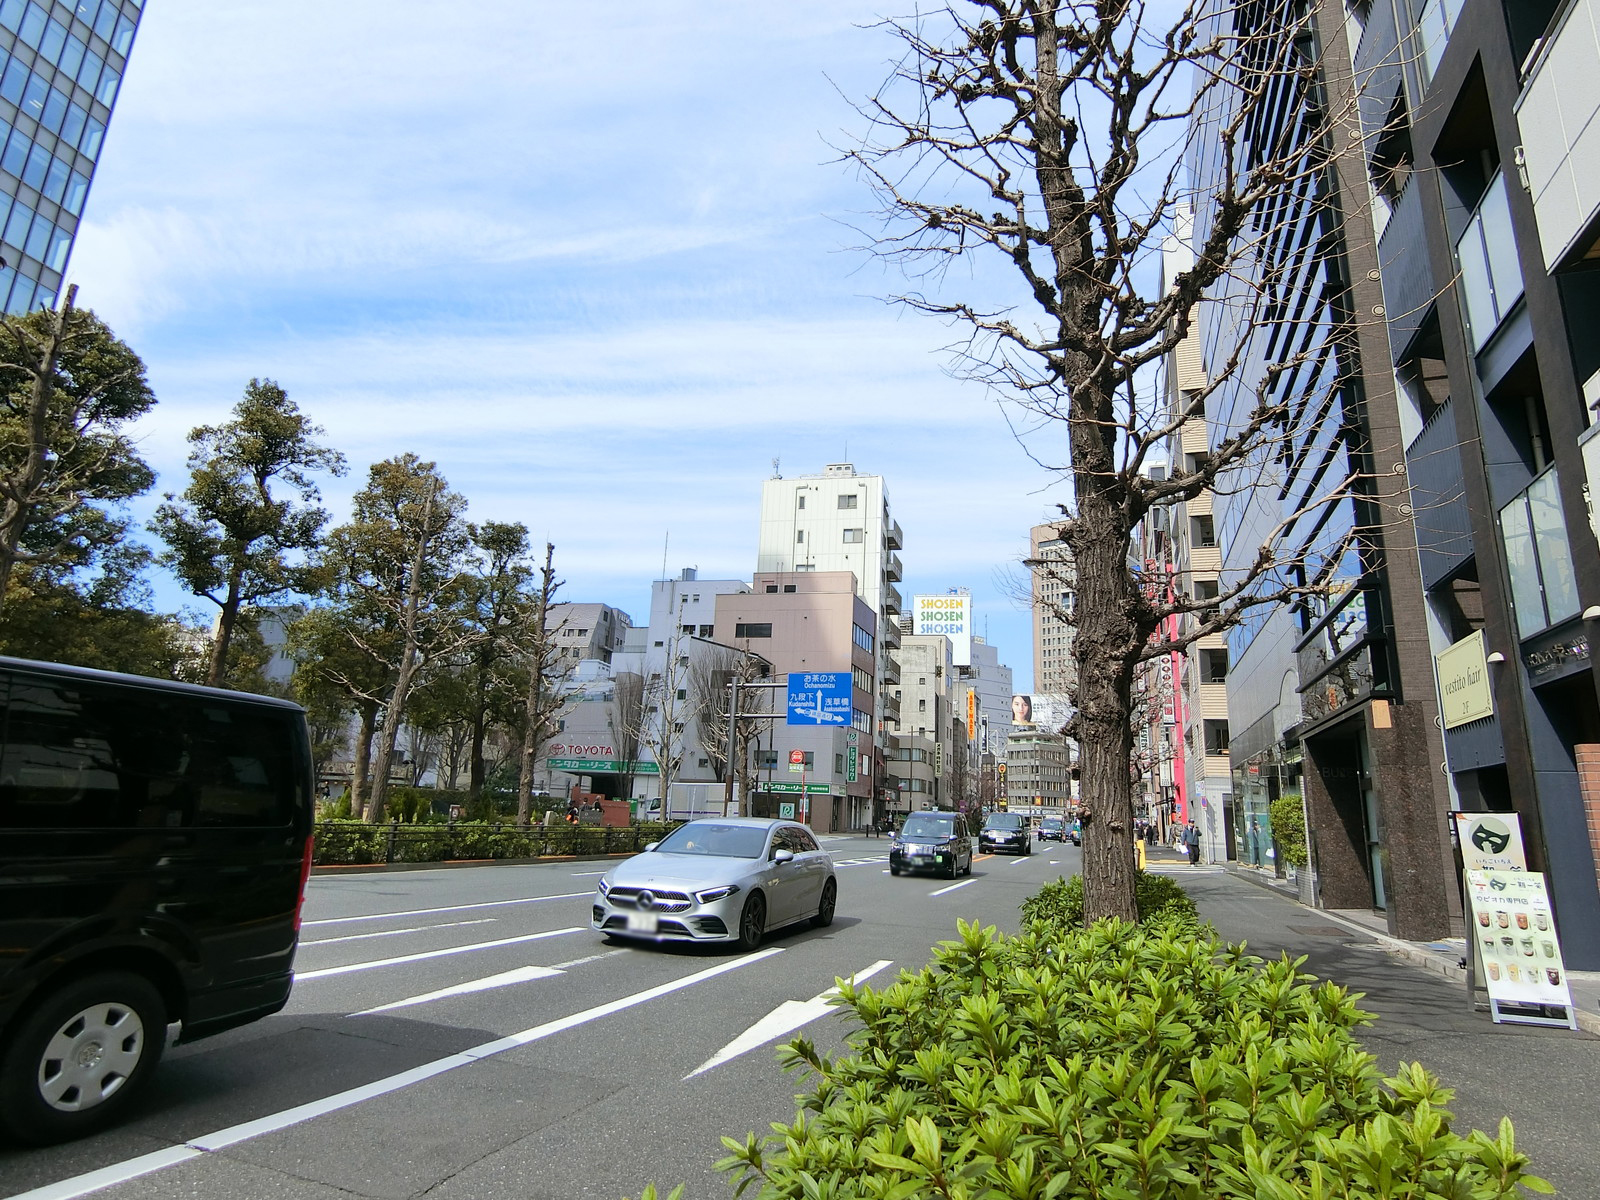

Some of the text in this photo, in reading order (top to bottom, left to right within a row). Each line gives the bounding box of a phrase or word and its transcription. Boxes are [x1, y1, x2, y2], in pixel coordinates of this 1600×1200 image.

[921, 599, 963, 609] SHOSEN
[921, 611, 963, 621] SHOSEN
[921, 624, 963, 633] SHOSEN
[803, 674, 836, 683] お茶の水
[1444, 665, 1482, 696] vestito hair
[789, 693, 815, 702] 九段下
[824, 698, 850, 706] 浅草橋
[1461, 701, 1470, 715] 2F
[568, 745, 614, 756] TOYOTA
[1476, 895, 1529, 905] タピオカ専門店
